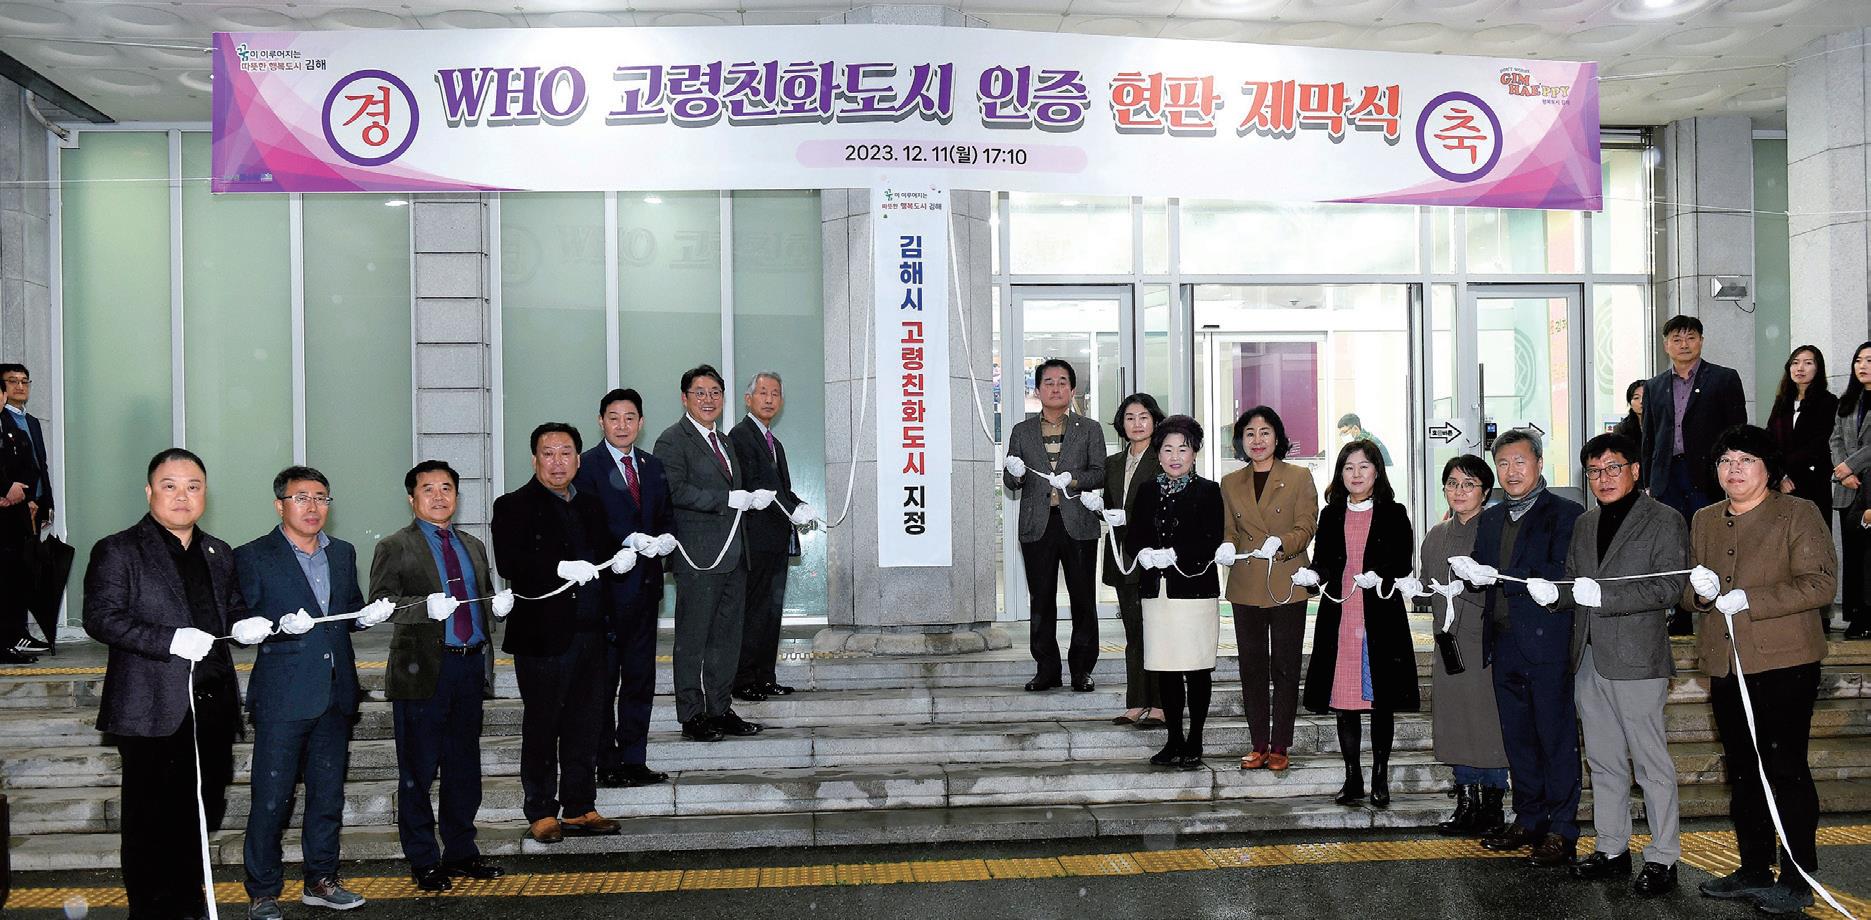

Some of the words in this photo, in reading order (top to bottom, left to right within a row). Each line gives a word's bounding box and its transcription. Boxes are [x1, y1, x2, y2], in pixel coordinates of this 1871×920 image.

[242, 62, 266, 71] 따뜻한
[269, 62, 302, 71] 행복도시
[305, 59, 327, 71] 김해
[260, 50, 302, 59] 이루어지는
[1500, 72, 1530, 86] GIM
[342, 85, 391, 147] 경
[436, 65, 588, 122] WHO
[606, 60, 953, 121] 고령친화도시
[979, 64, 1089, 125] 인증
[1111, 71, 1222, 130] 현판
[1239, 80, 1401, 139] 제막식
[845, 144, 898, 162] 2023.
[903, 145, 927, 163] 12.
[932, 145, 978, 165] 11(월)
[983, 147, 1027, 165] 17:10
[1434, 107, 1487, 165] 축
[900, 202, 927, 210] 행복도시
[900, 235, 923, 311] 김해시
[900, 321, 926, 475] 고령친화도시
[903, 485, 926, 536] 지정
